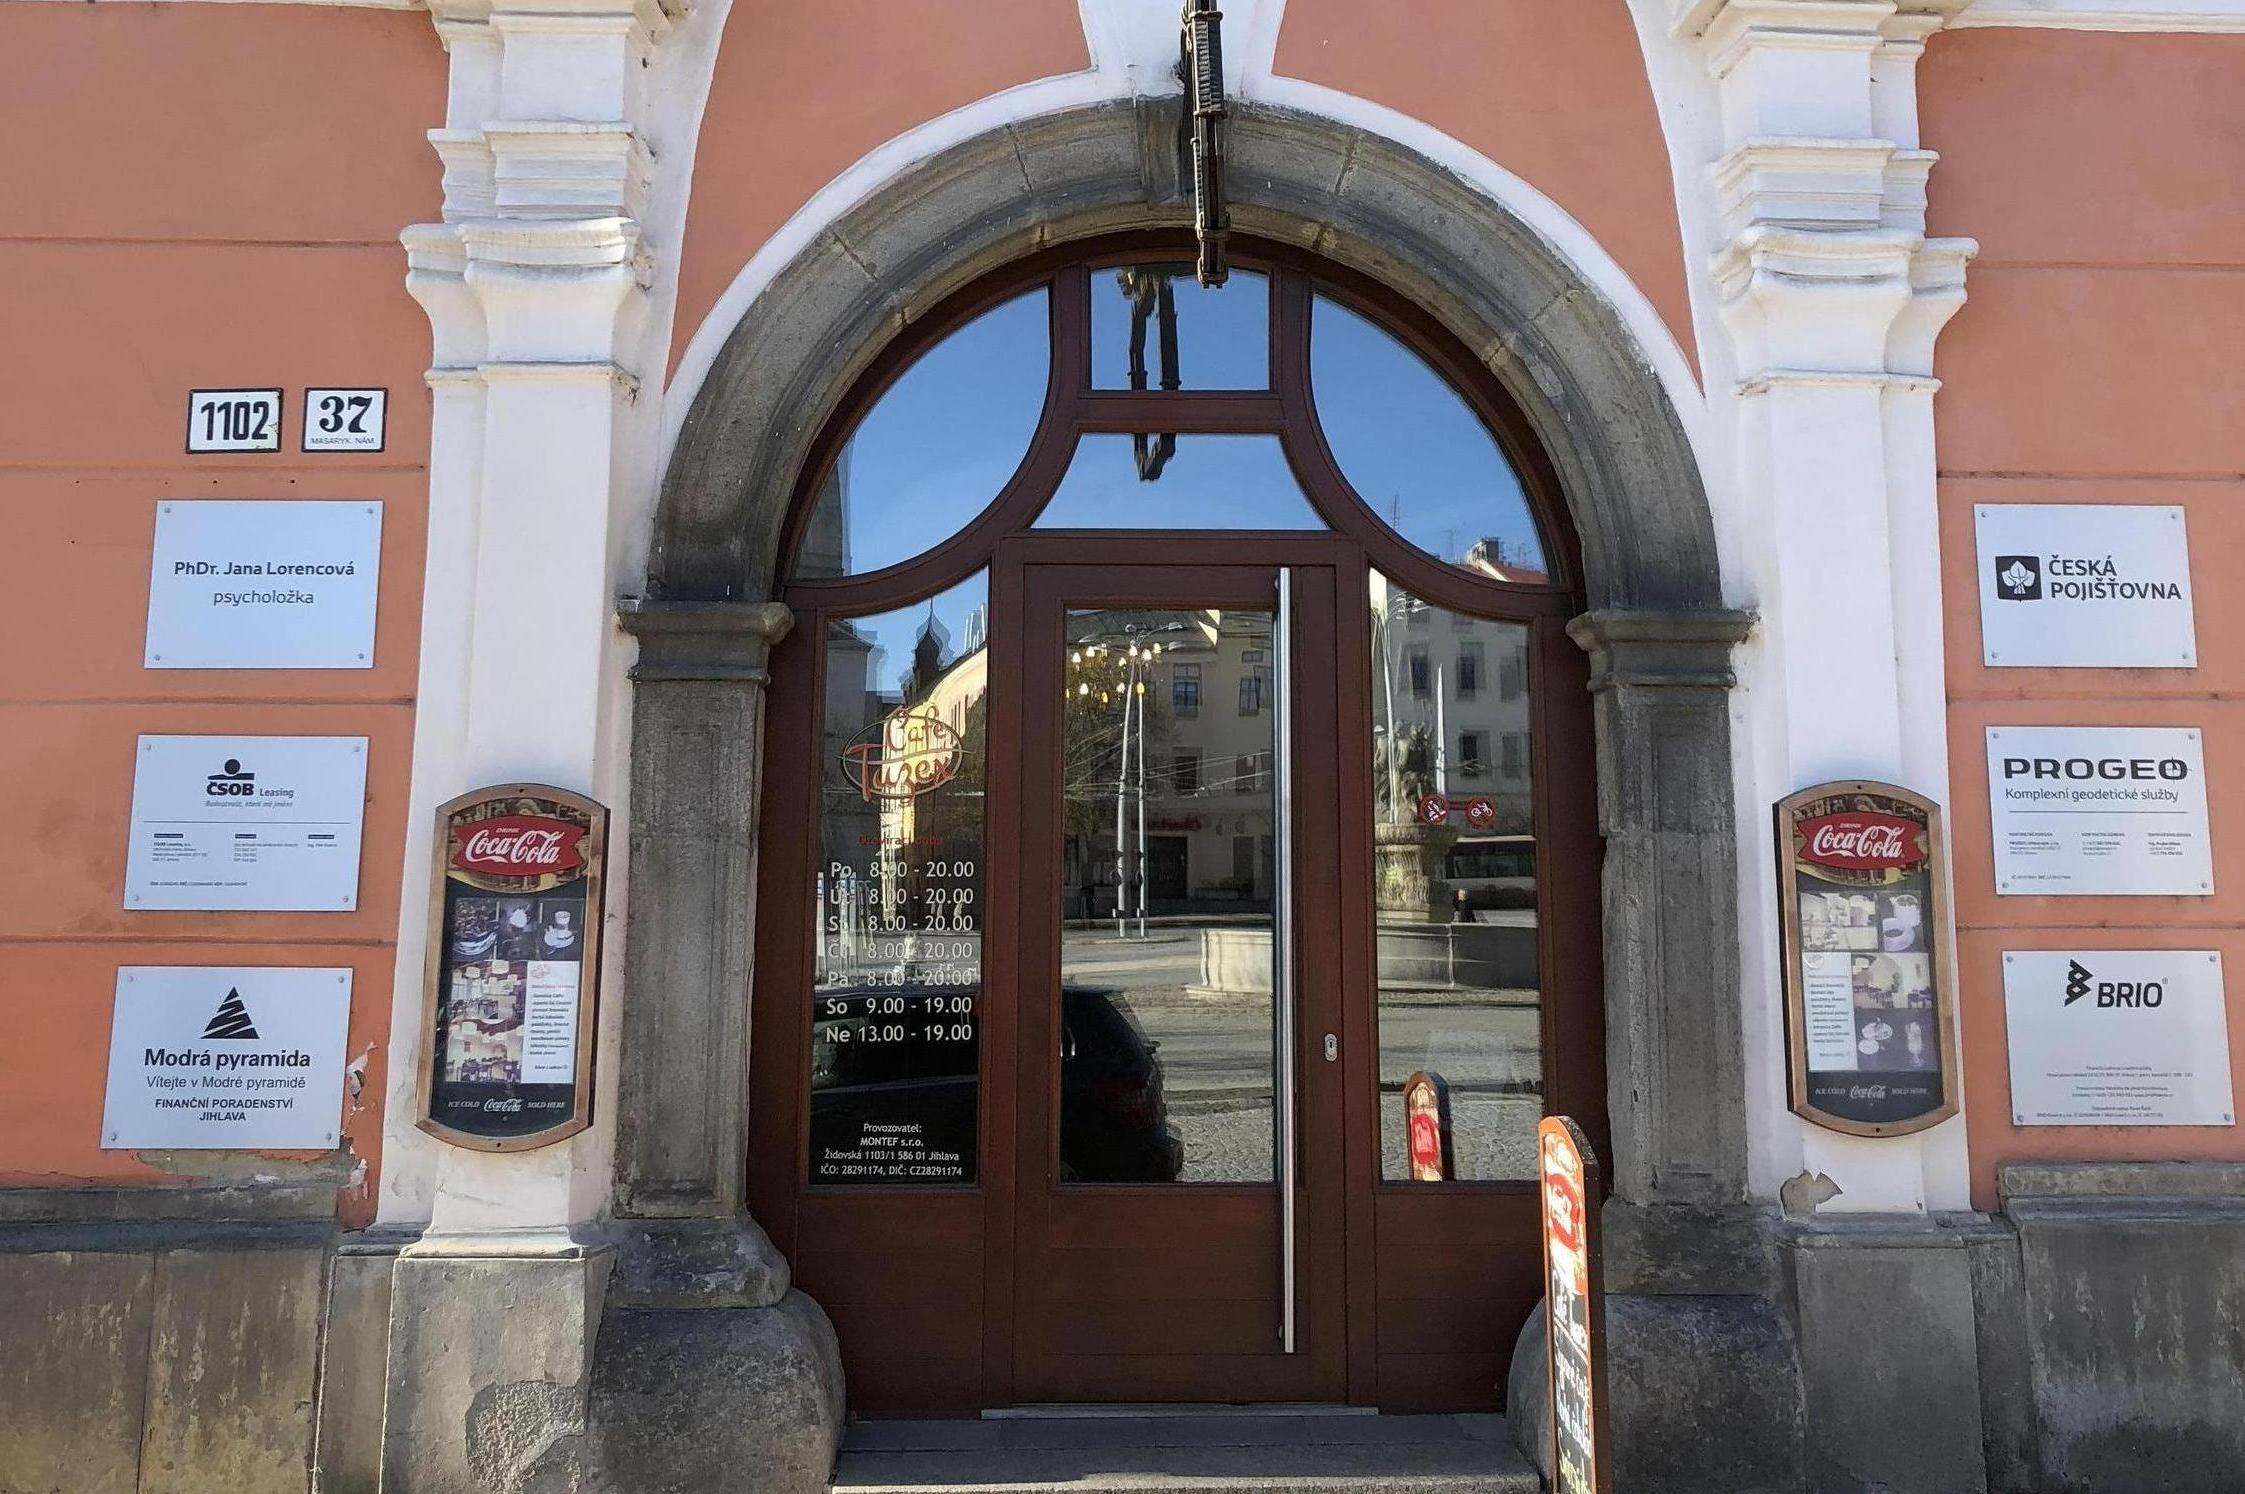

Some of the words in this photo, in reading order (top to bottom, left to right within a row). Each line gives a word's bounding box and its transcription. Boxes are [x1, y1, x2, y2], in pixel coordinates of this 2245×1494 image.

[201, 401, 270, 441] 1102
[319, 396, 373, 433] 37
[174, 561, 219, 576] PhDr.
[223, 561, 262, 576] Jana
[266, 560, 355, 576] Lorencová
[2049, 555, 2118, 576] ČESKÁ
[213, 589, 314, 607] psycholožka
[2051, 578, 2182, 602] POJIŠŤOVNA
[2004, 757, 2189, 781] PROGEO
[206, 781, 255, 796] ČSOB
[259, 788, 294, 798] Leasing
[2005, 788, 2070, 802] Komplexní
[2072, 788, 2138, 802] geodetické
[2141, 788, 2179, 803] služby
[465, 829, 565, 864] Coca-Cola
[1812, 824, 1905, 858] Coca-Cola
[831, 862, 852, 878] Po
[926, 861, 974, 878] 20.00
[926, 888, 974, 904] 20.00
[868, 915, 906, 932] 8.00
[925, 915, 973, 932] 20.00
[868, 943, 906, 959] 8.00
[925, 943, 973, 959] 20.00
[867, 971, 905, 987] 8.00
[924, 971, 972, 987] 20.00
[2097, 982, 2163, 1008] BRIO
[826, 999, 848, 1014] So
[866, 998, 905, 1014] 9.00
[925, 997, 972, 1014] 19.00
[826, 1027, 850, 1042] Ne
[859, 1026, 904, 1042] 13.00
[925, 1025, 972, 1042] 19.00
[144, 1048, 211, 1067] Modrá
[216, 1049, 311, 1070] pyramida
[146, 1075, 187, 1090] Vítejte
[191, 1078, 199, 1088] v
[202, 1075, 243, 1088] Modré
[246, 1076, 306, 1091] pyramidě
[155, 1095, 209, 1109] FINANČNÍ
[211, 1096, 294, 1109] PORADENSTVÍ
[199, 1111, 247, 1122] JIHLAVA
[863, 1123, 922, 1133] Provozovatel:
[860, 1137, 899, 1147] MONTEF
[900, 1138, 924, 1147] s.r.o.
[824, 1148, 862, 1160] Židovská
[865, 1151, 895, 1161] 1103/1
[897, 1151, 914, 1161] 586
[915, 1152, 926, 1161] 01
[928, 1152, 960, 1161] Jihlava
[820, 1163, 839, 1174] IČO:
[841, 1165, 886, 1176] 28291174,
[889, 1164, 907, 1175] DIČ:
[909, 1166, 963, 1176] CZ28291174
